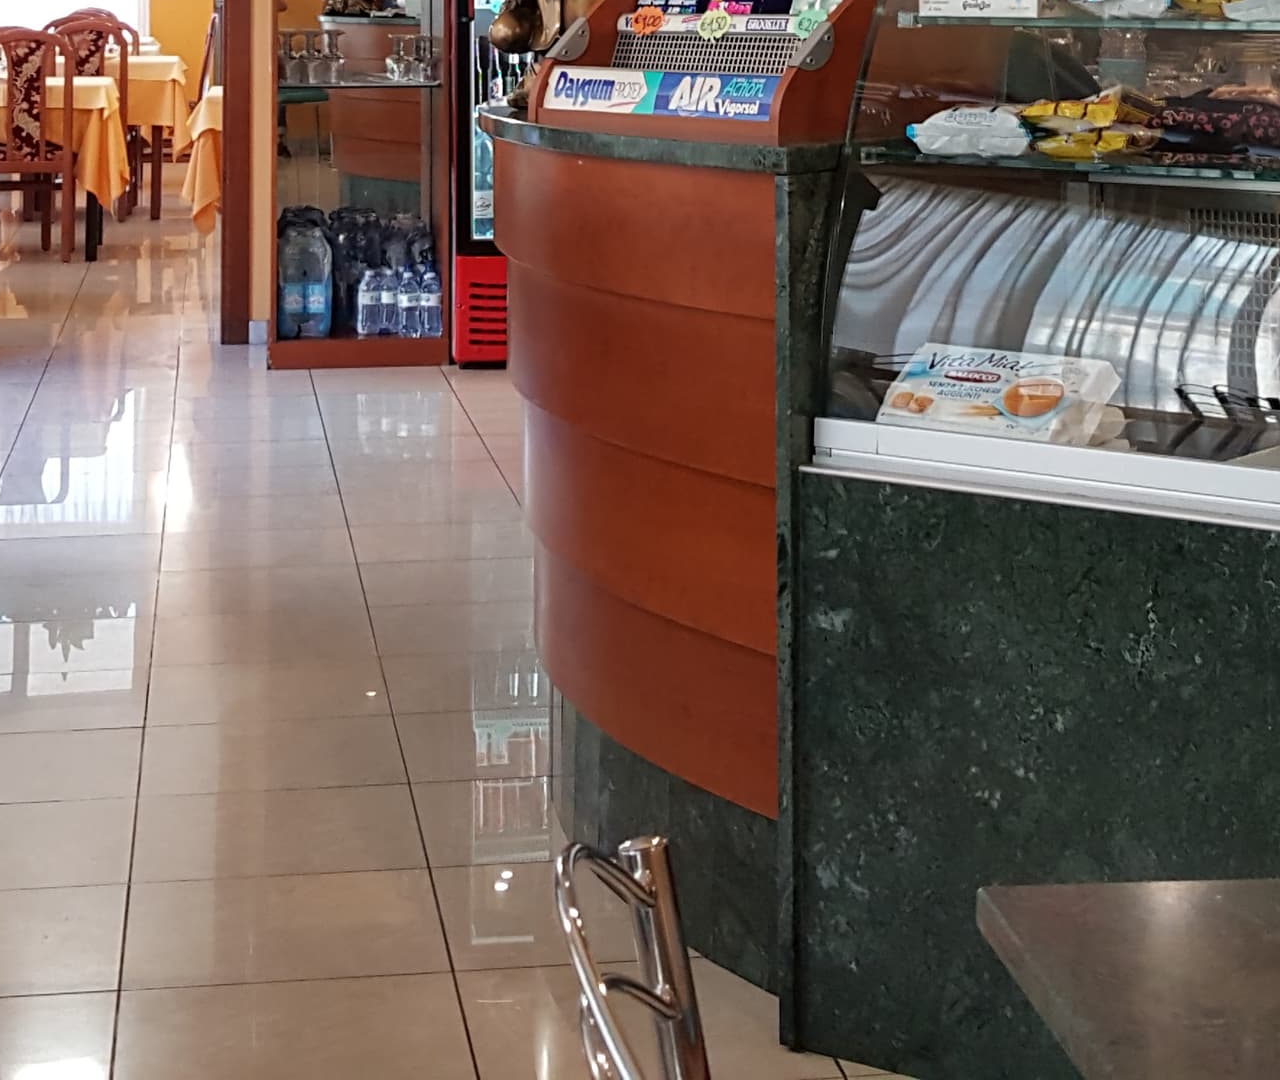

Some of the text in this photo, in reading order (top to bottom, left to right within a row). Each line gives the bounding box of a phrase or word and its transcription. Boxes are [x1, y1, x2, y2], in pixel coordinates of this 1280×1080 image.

[554, 70, 616, 107] Daygum
[668, 75, 765, 113] AIR Action
[716, 98, 760, 117] Vigorsol
[928, 352, 975, 371] Vita
